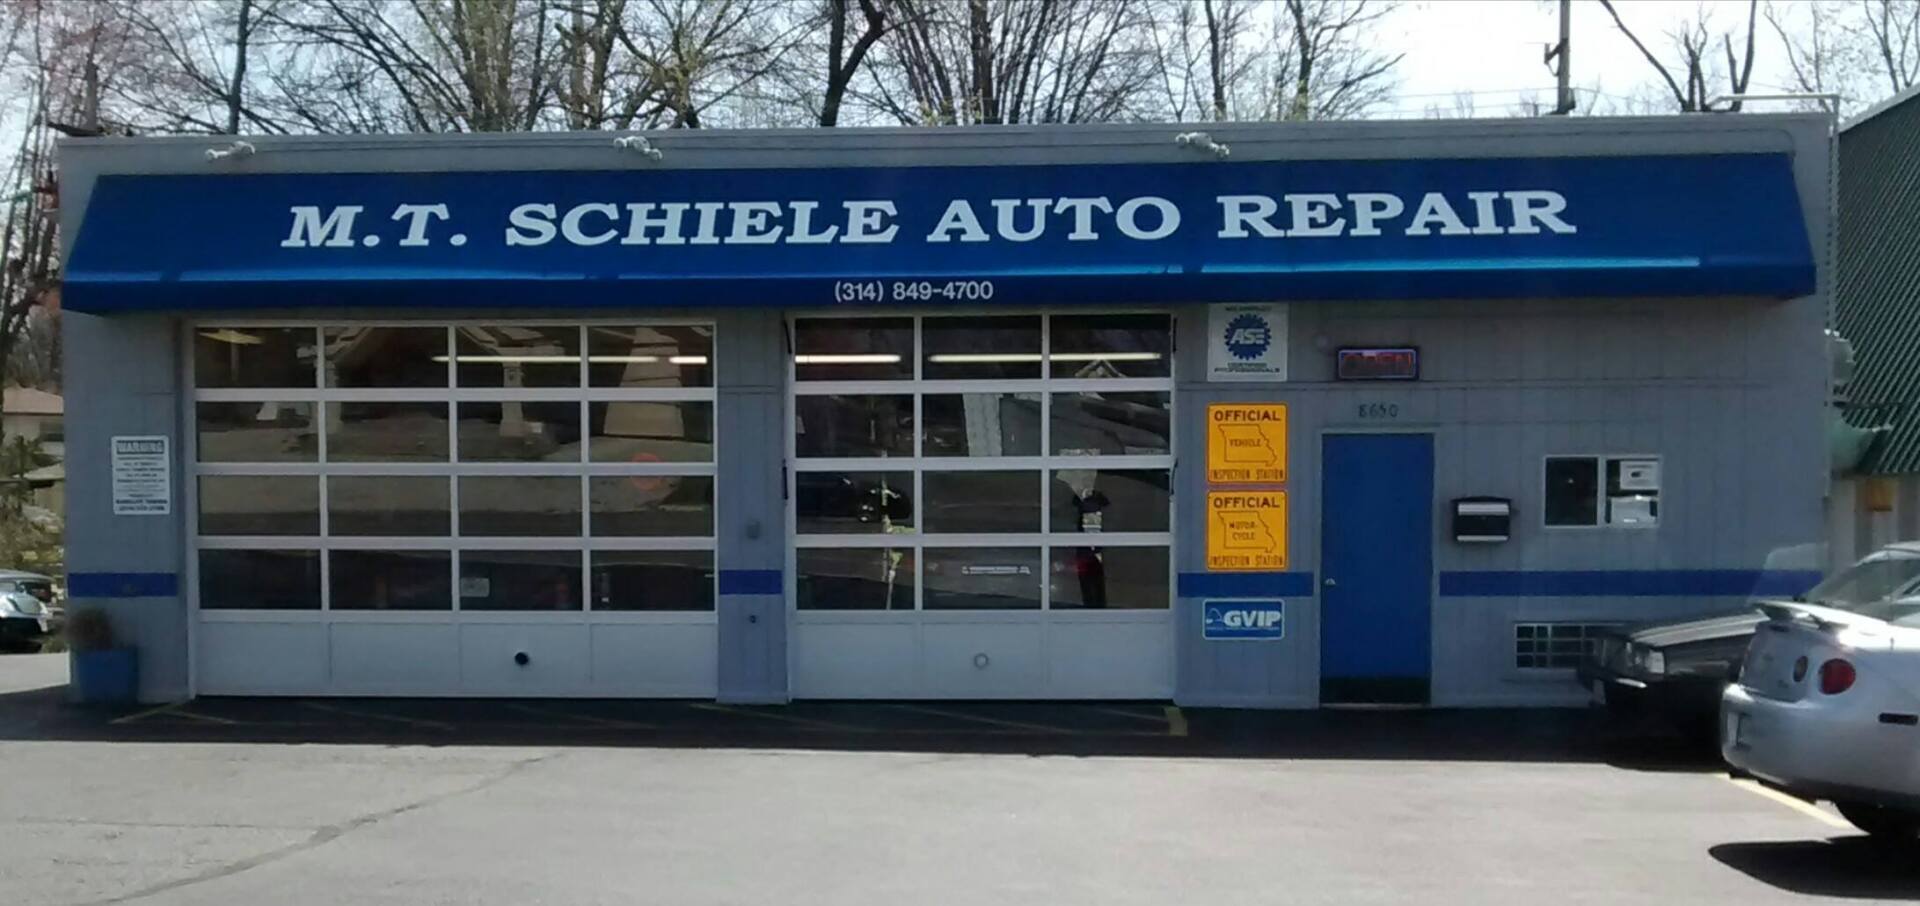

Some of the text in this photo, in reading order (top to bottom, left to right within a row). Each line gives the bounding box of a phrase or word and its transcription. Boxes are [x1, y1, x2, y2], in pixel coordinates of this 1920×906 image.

[282, 191, 1577, 247] M.T. SCHIELE AUTO REPAIR
[834, 280, 994, 302] (314) 849-4700
[1230, 327, 1265, 345] ASE
[1213, 409, 1281, 422] OFFICIAL
[1228, 438, 1262, 448] VEHICLE
[1210, 468, 1284, 480] INSPECTION STATION
[1213, 496, 1281, 509] OFFICIAL
[1209, 555, 1284, 567] INSPECTION STATION
[1223, 610, 1282, 628] GVIP
